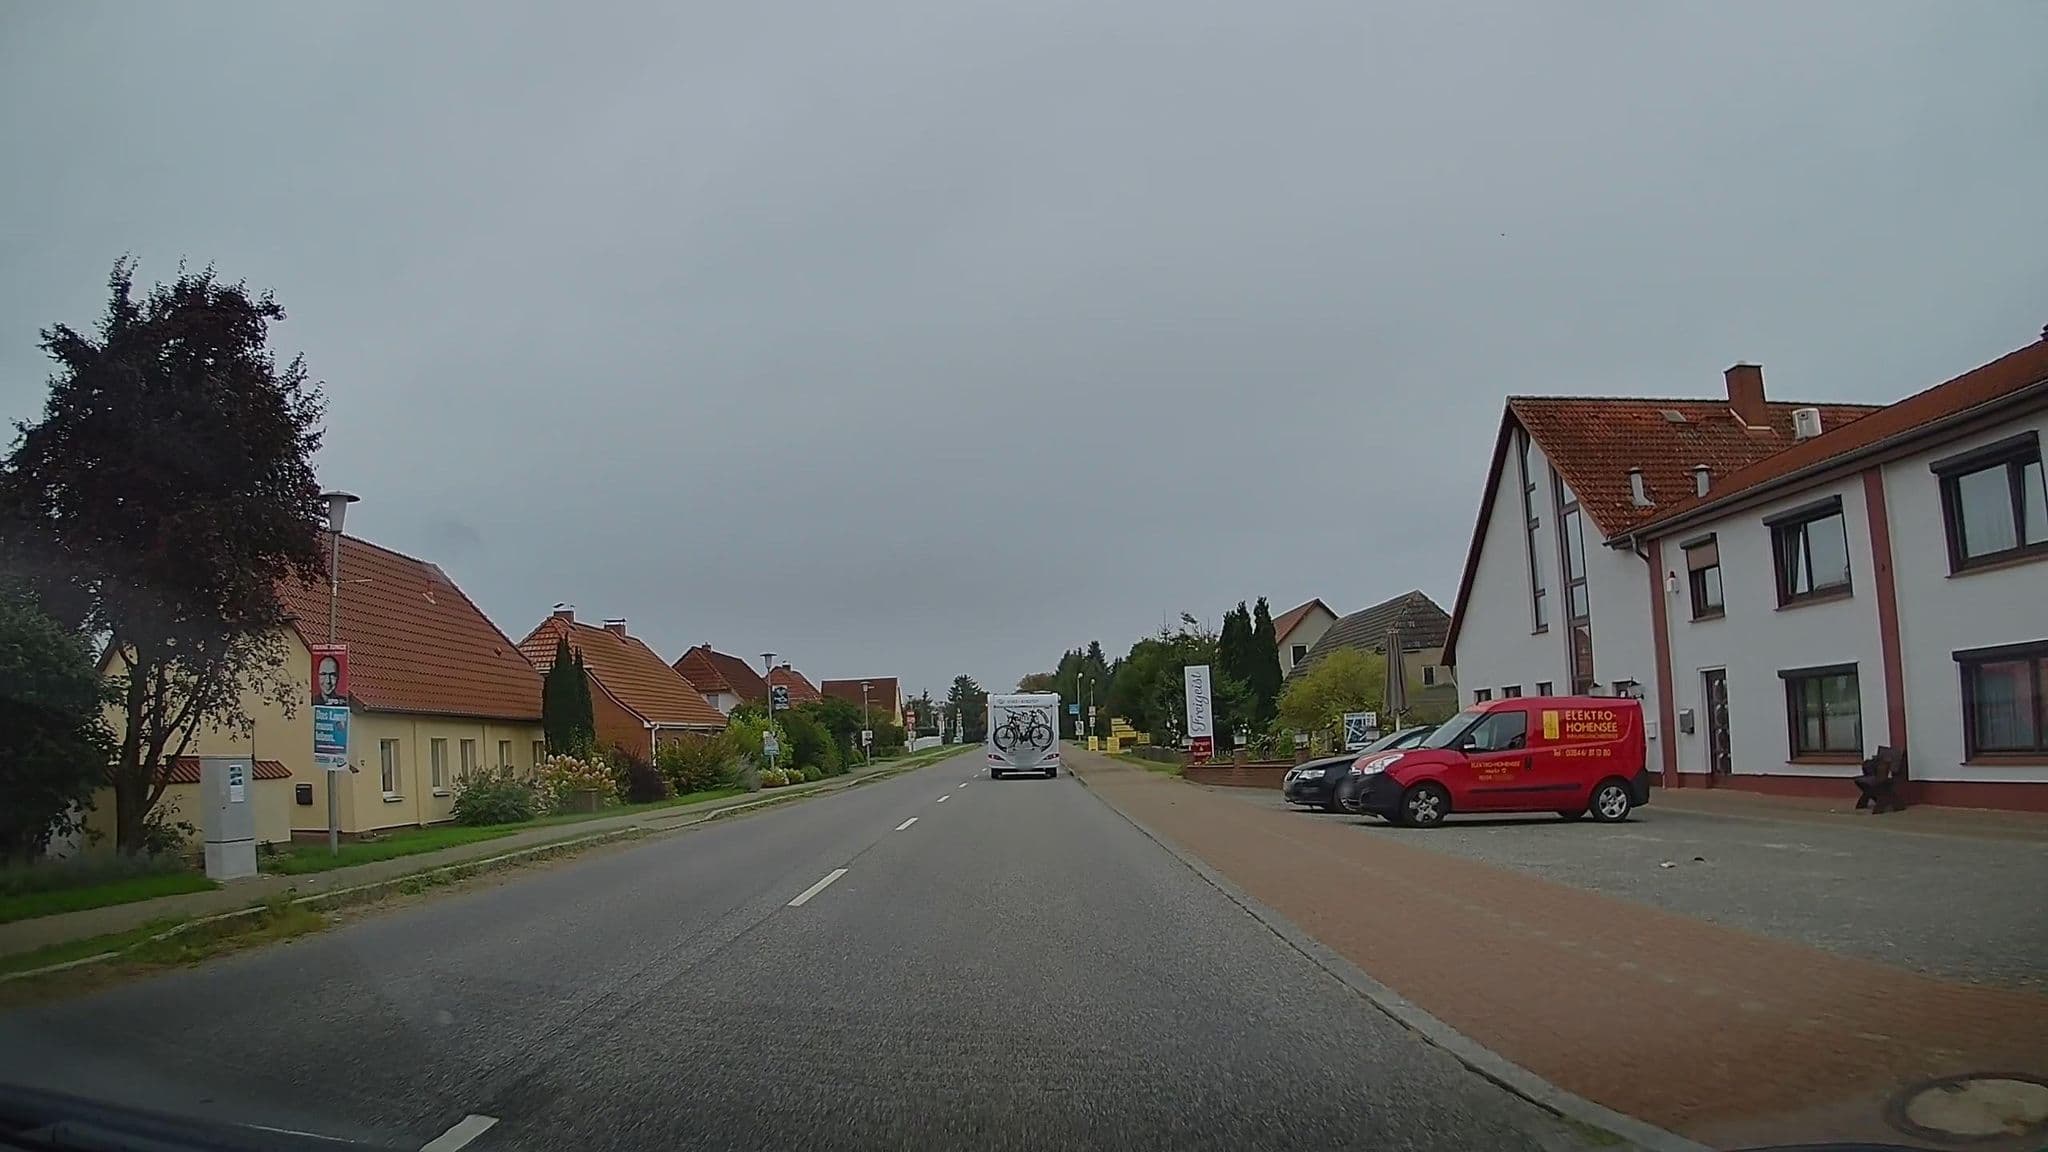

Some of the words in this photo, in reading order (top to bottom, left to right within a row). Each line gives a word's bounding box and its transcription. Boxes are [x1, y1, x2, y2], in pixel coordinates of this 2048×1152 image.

[1191, 671, 1209, 732] Freigeist
[1565, 710, 1617, 721] ELEKTRO-
[1566, 722, 1618, 733] HOHENSEE
